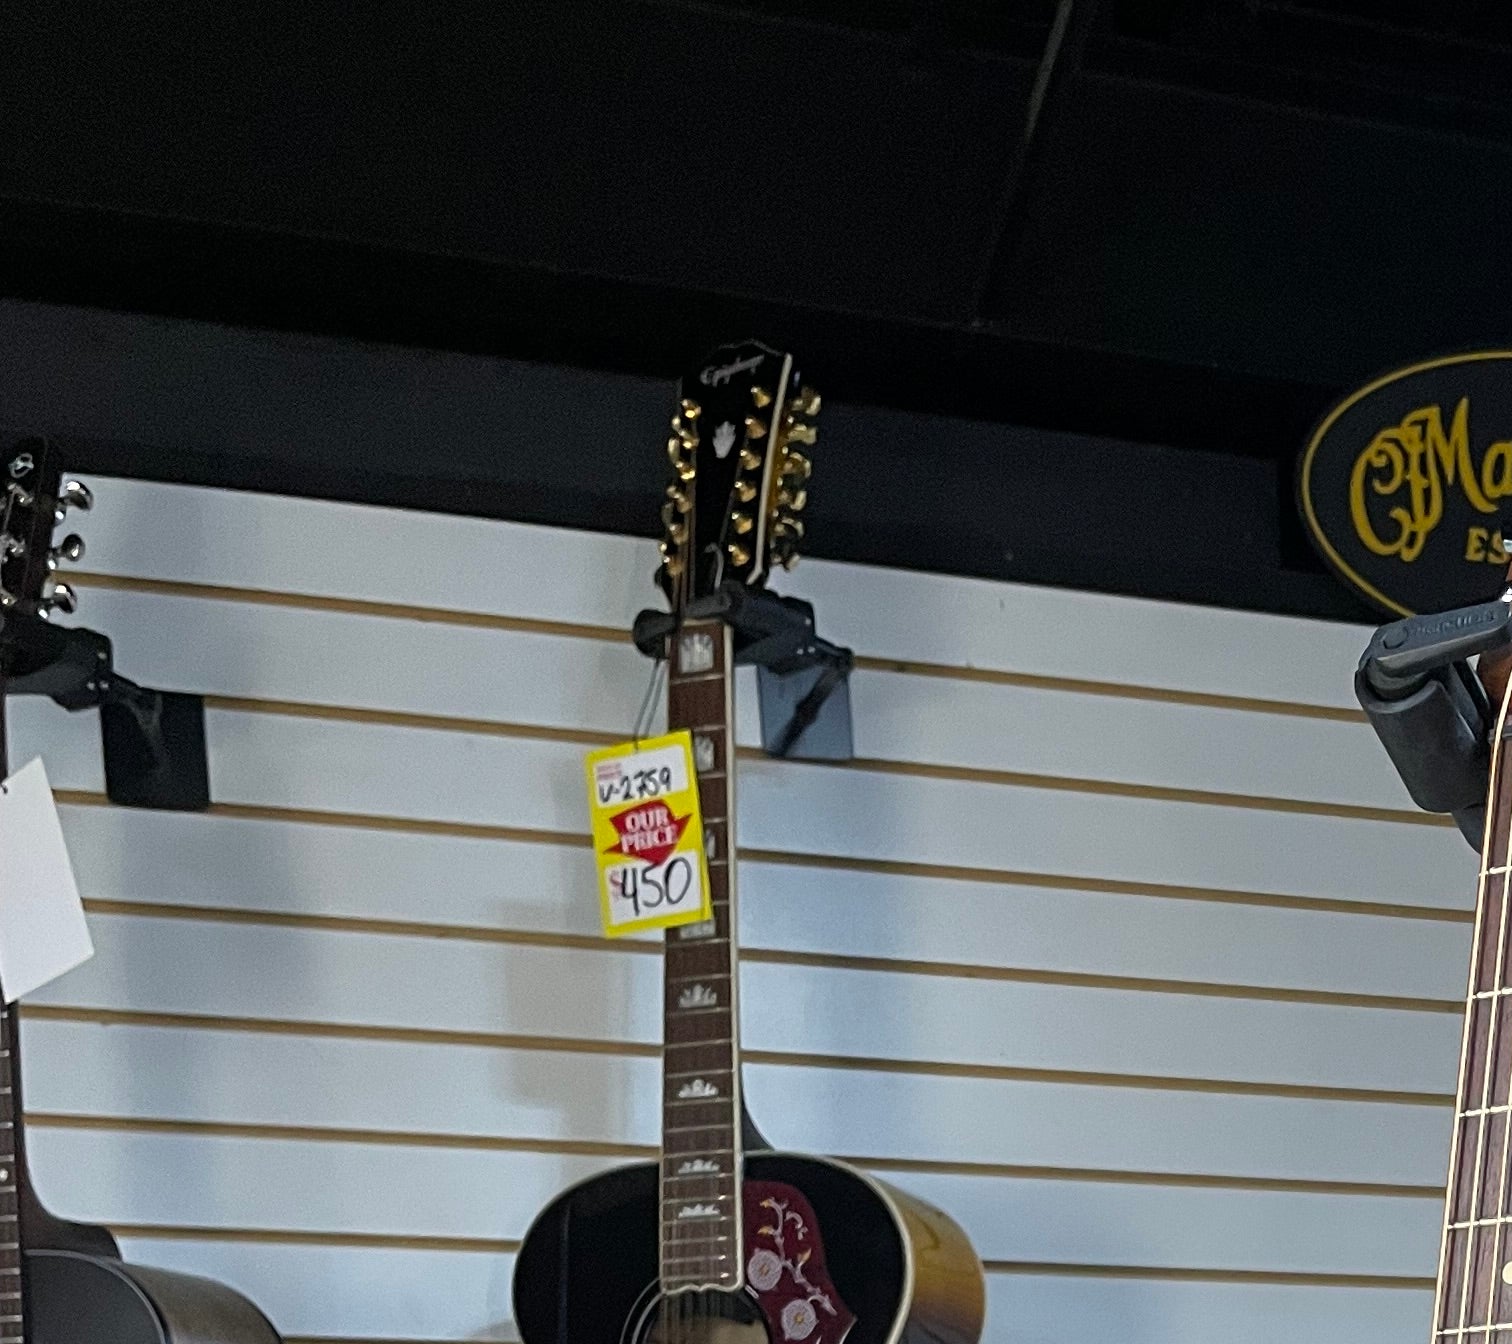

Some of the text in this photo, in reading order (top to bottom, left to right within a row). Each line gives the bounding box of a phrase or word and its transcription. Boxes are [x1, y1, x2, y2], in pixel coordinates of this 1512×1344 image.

[1465, 526, 1512, 566] ES
[625, 806, 670, 834] OUR
[620, 823, 679, 853] PRICE
